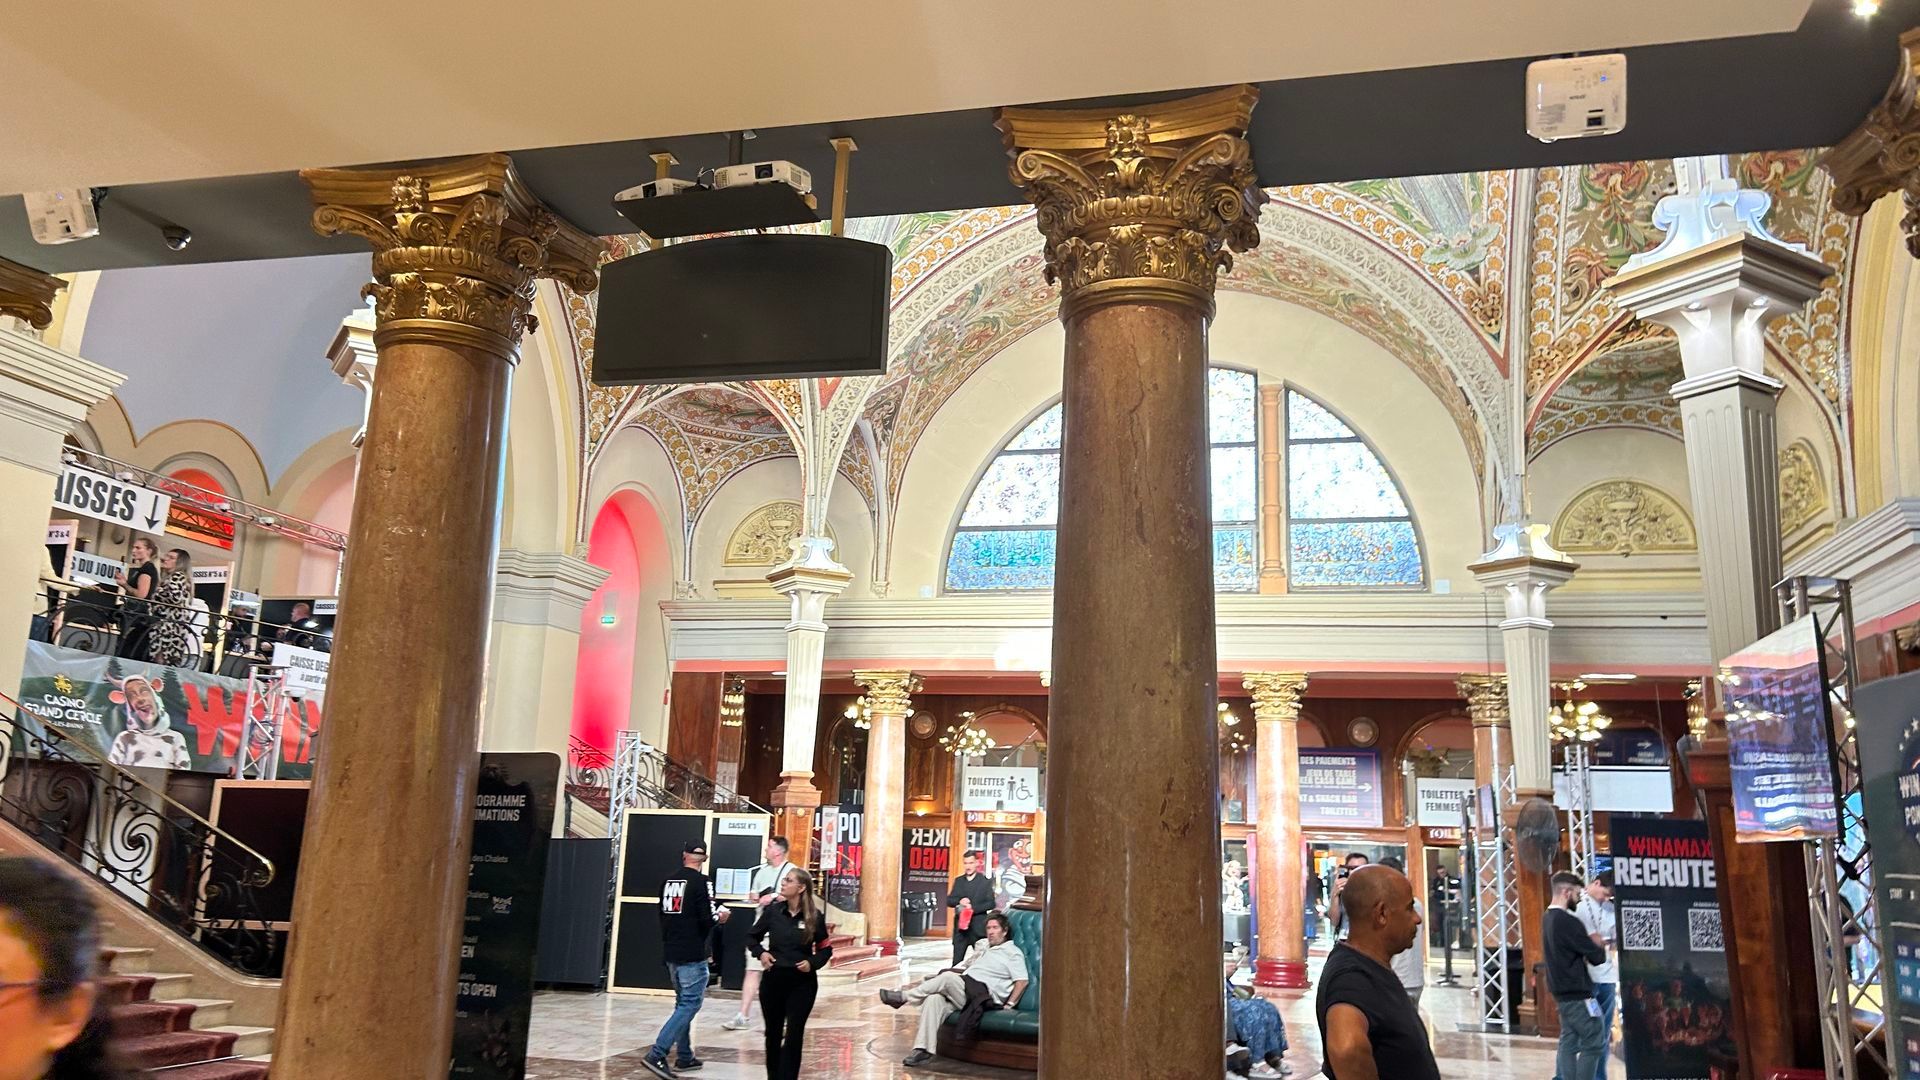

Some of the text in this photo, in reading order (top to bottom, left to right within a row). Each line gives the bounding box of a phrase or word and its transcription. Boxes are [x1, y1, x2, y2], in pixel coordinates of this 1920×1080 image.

[78, 558, 93, 574] DU
[290, 655, 314, 670] CAISSE
[44, 694, 86, 709] CASINO
[65, 709, 102, 725] CERCLE
[968, 777, 1005, 786] TOILETTES
[969, 789, 1002, 798] HOMMES
[1421, 789, 1464, 799] TOILETTES
[1426, 802, 1461, 812] FEMMES
[1627, 835, 1713, 858] WINAMAX
[1613, 856, 1717, 888] RECRUTE
[471, 983, 497, 997] OPEN
